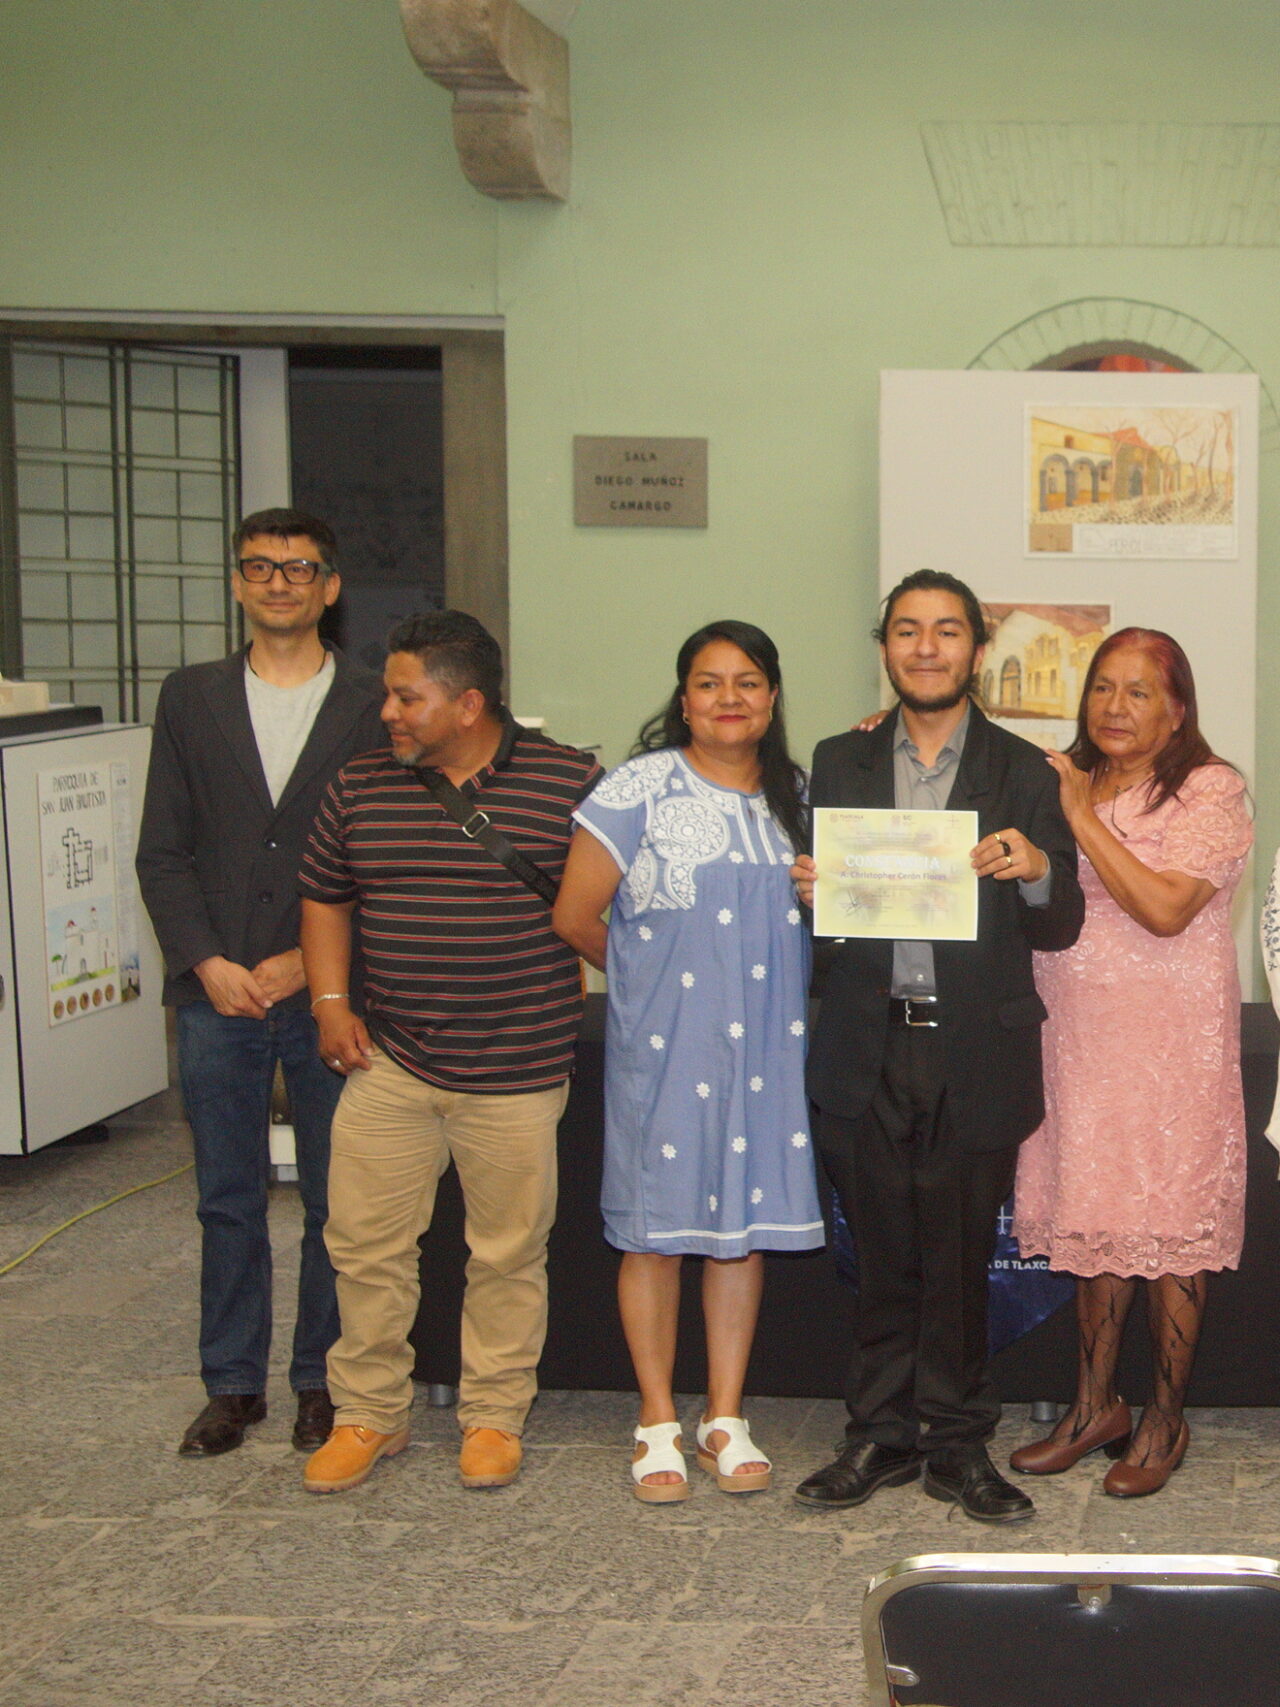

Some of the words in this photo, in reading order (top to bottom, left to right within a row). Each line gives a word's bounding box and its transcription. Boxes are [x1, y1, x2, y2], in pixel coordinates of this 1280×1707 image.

[625, 452, 657, 462] SALA
[594, 475, 633, 486] DIEGO
[610, 501, 671, 511] CAMARGO
[90, 771, 99, 786] DE
[41, 800, 56, 816] SAN
[59, 796, 74, 812] JUAN
[76, 791, 105, 809] BAUTISTA
[846, 855, 939, 869] CONSANCIA
[851, 872, 896, 880] Christopher
[994, 1260, 1009, 1269] DE
[1011, 1260, 1050, 1270] TLAXC
